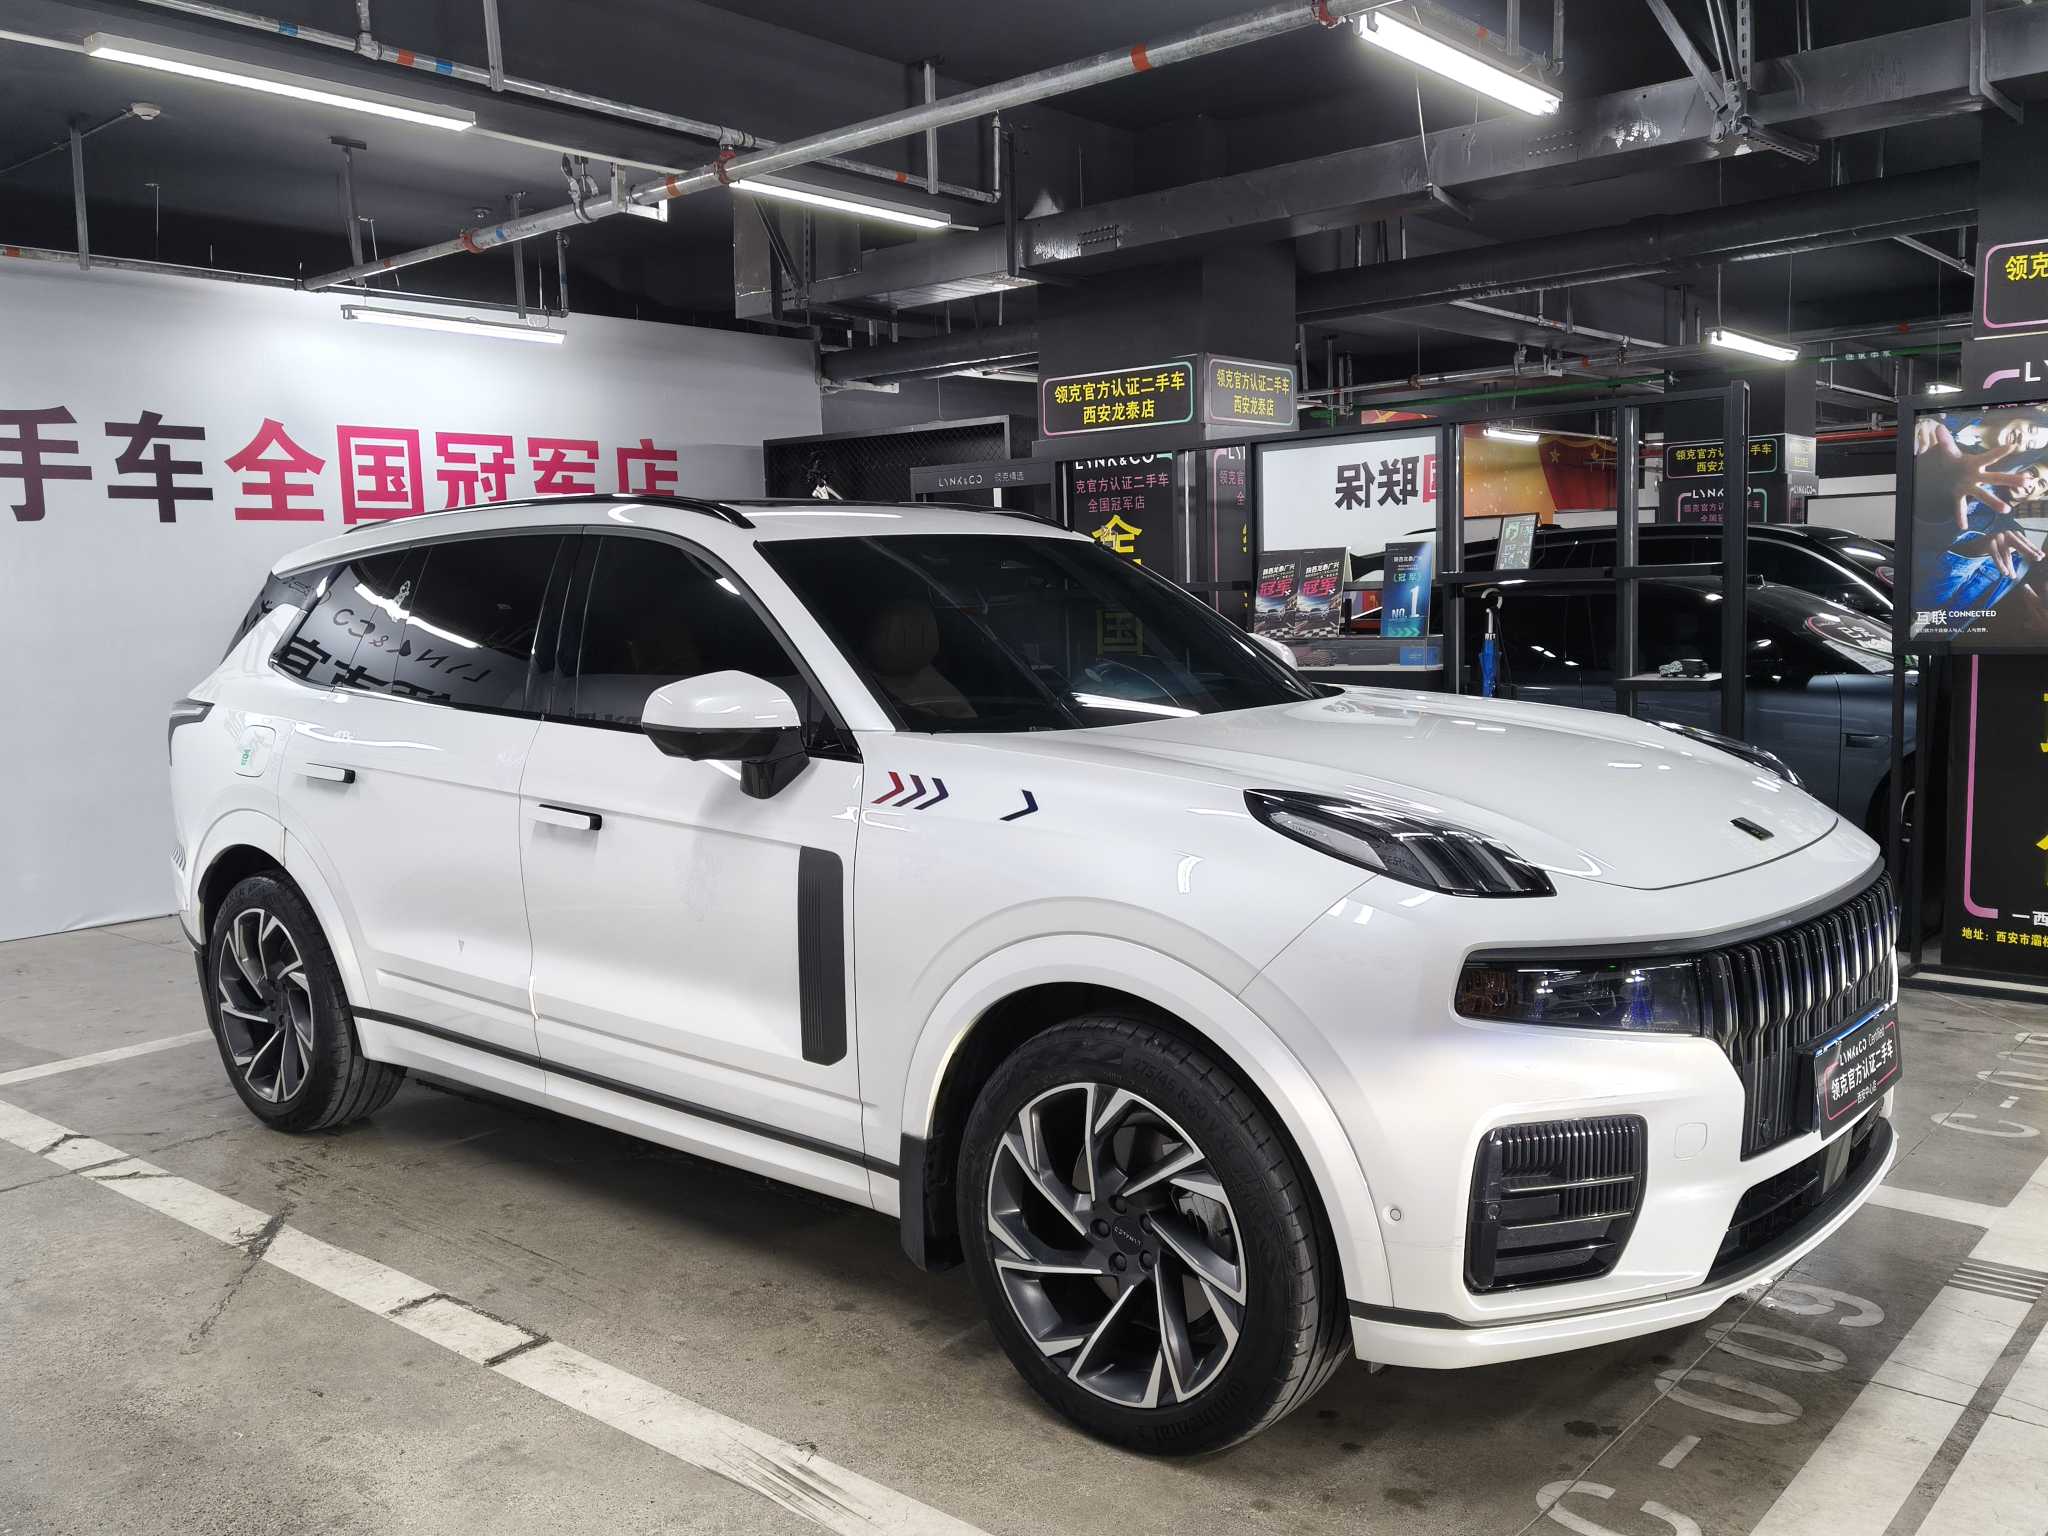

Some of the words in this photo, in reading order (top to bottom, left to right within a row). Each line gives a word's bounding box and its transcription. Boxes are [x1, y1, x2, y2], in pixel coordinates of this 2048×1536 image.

[1216, 368, 1290, 395] 领克官方认证二手车
[2025, 359, 2048, 383] L
[1055, 371, 1185, 404] 领克官方认证二手车
[1083, 399, 1155, 425] 西安龙泰店
[1233, 394, 1274, 417] 西安龙泰店
[1087, 495, 1146, 513] 全国冠军店
[1914, 609, 1947, 625] 互联
[1948, 610, 1997, 618] CONNECTED
[1831, 1039, 1893, 1101] 领克官方认证二手车
